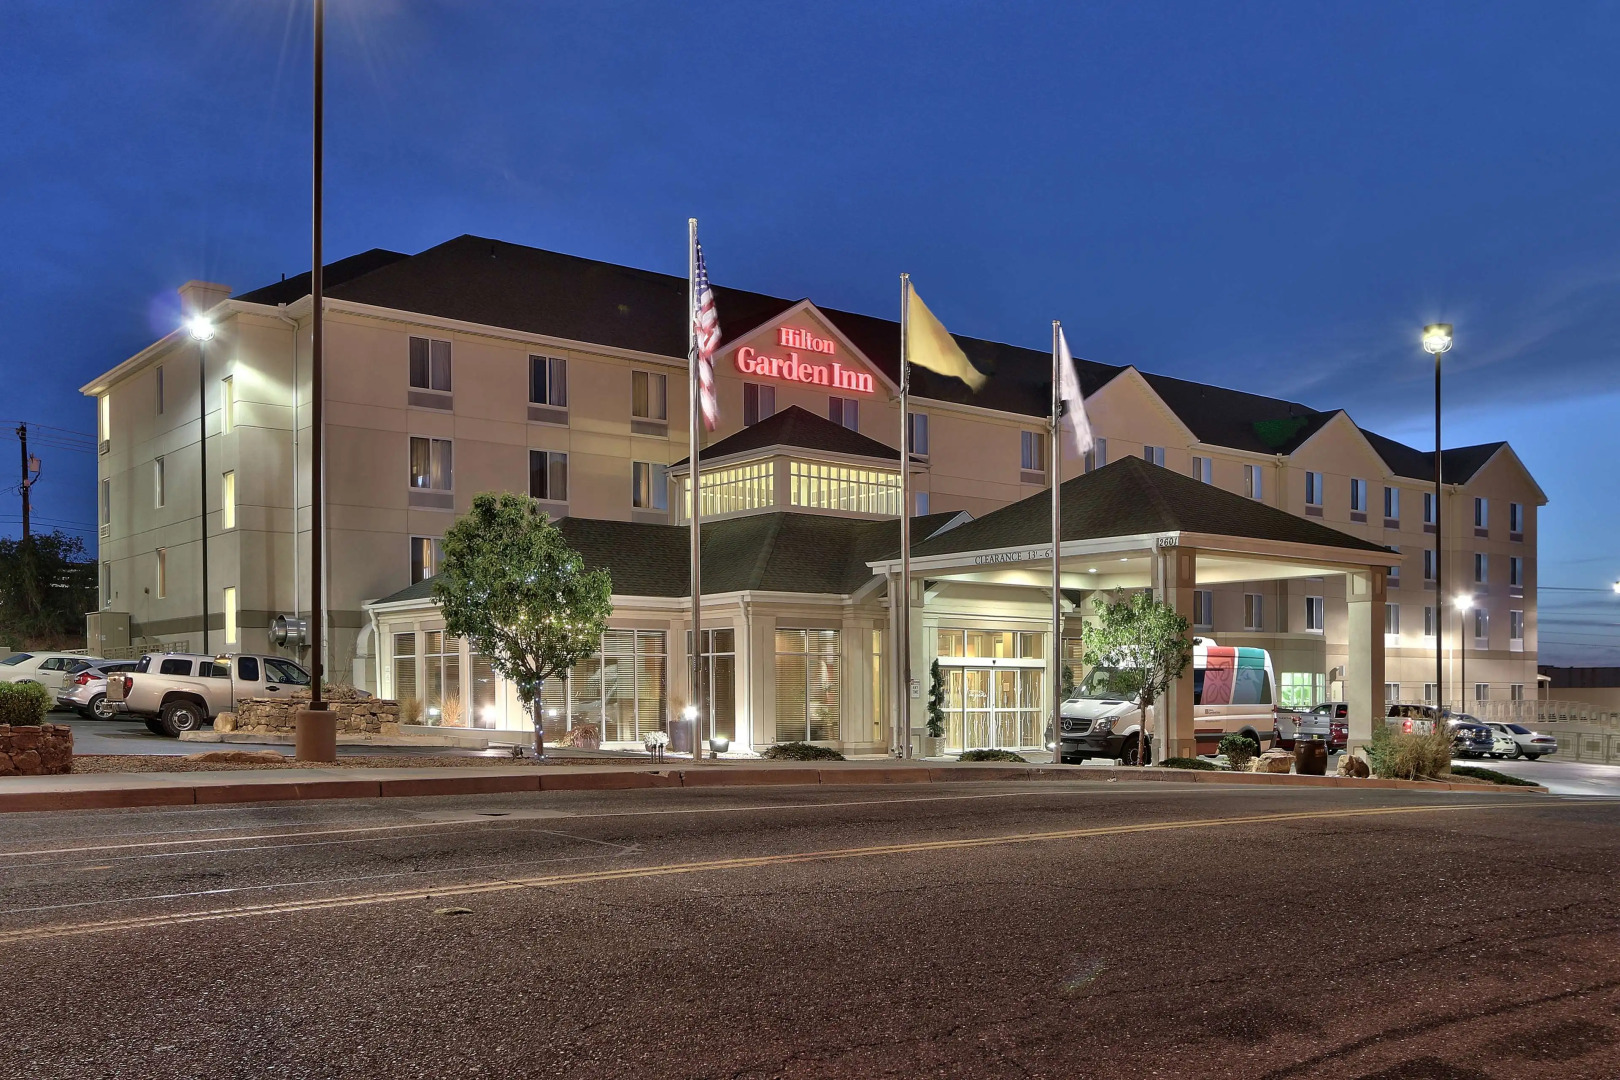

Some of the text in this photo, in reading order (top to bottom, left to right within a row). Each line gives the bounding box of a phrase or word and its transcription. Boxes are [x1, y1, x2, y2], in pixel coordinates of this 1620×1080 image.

[779, 327, 836, 354] Hilton
[736, 346, 875, 393] Garden Inn
[1159, 537, 1178, 547] 2601
[974, 551, 1022, 565] CLEARANCE
